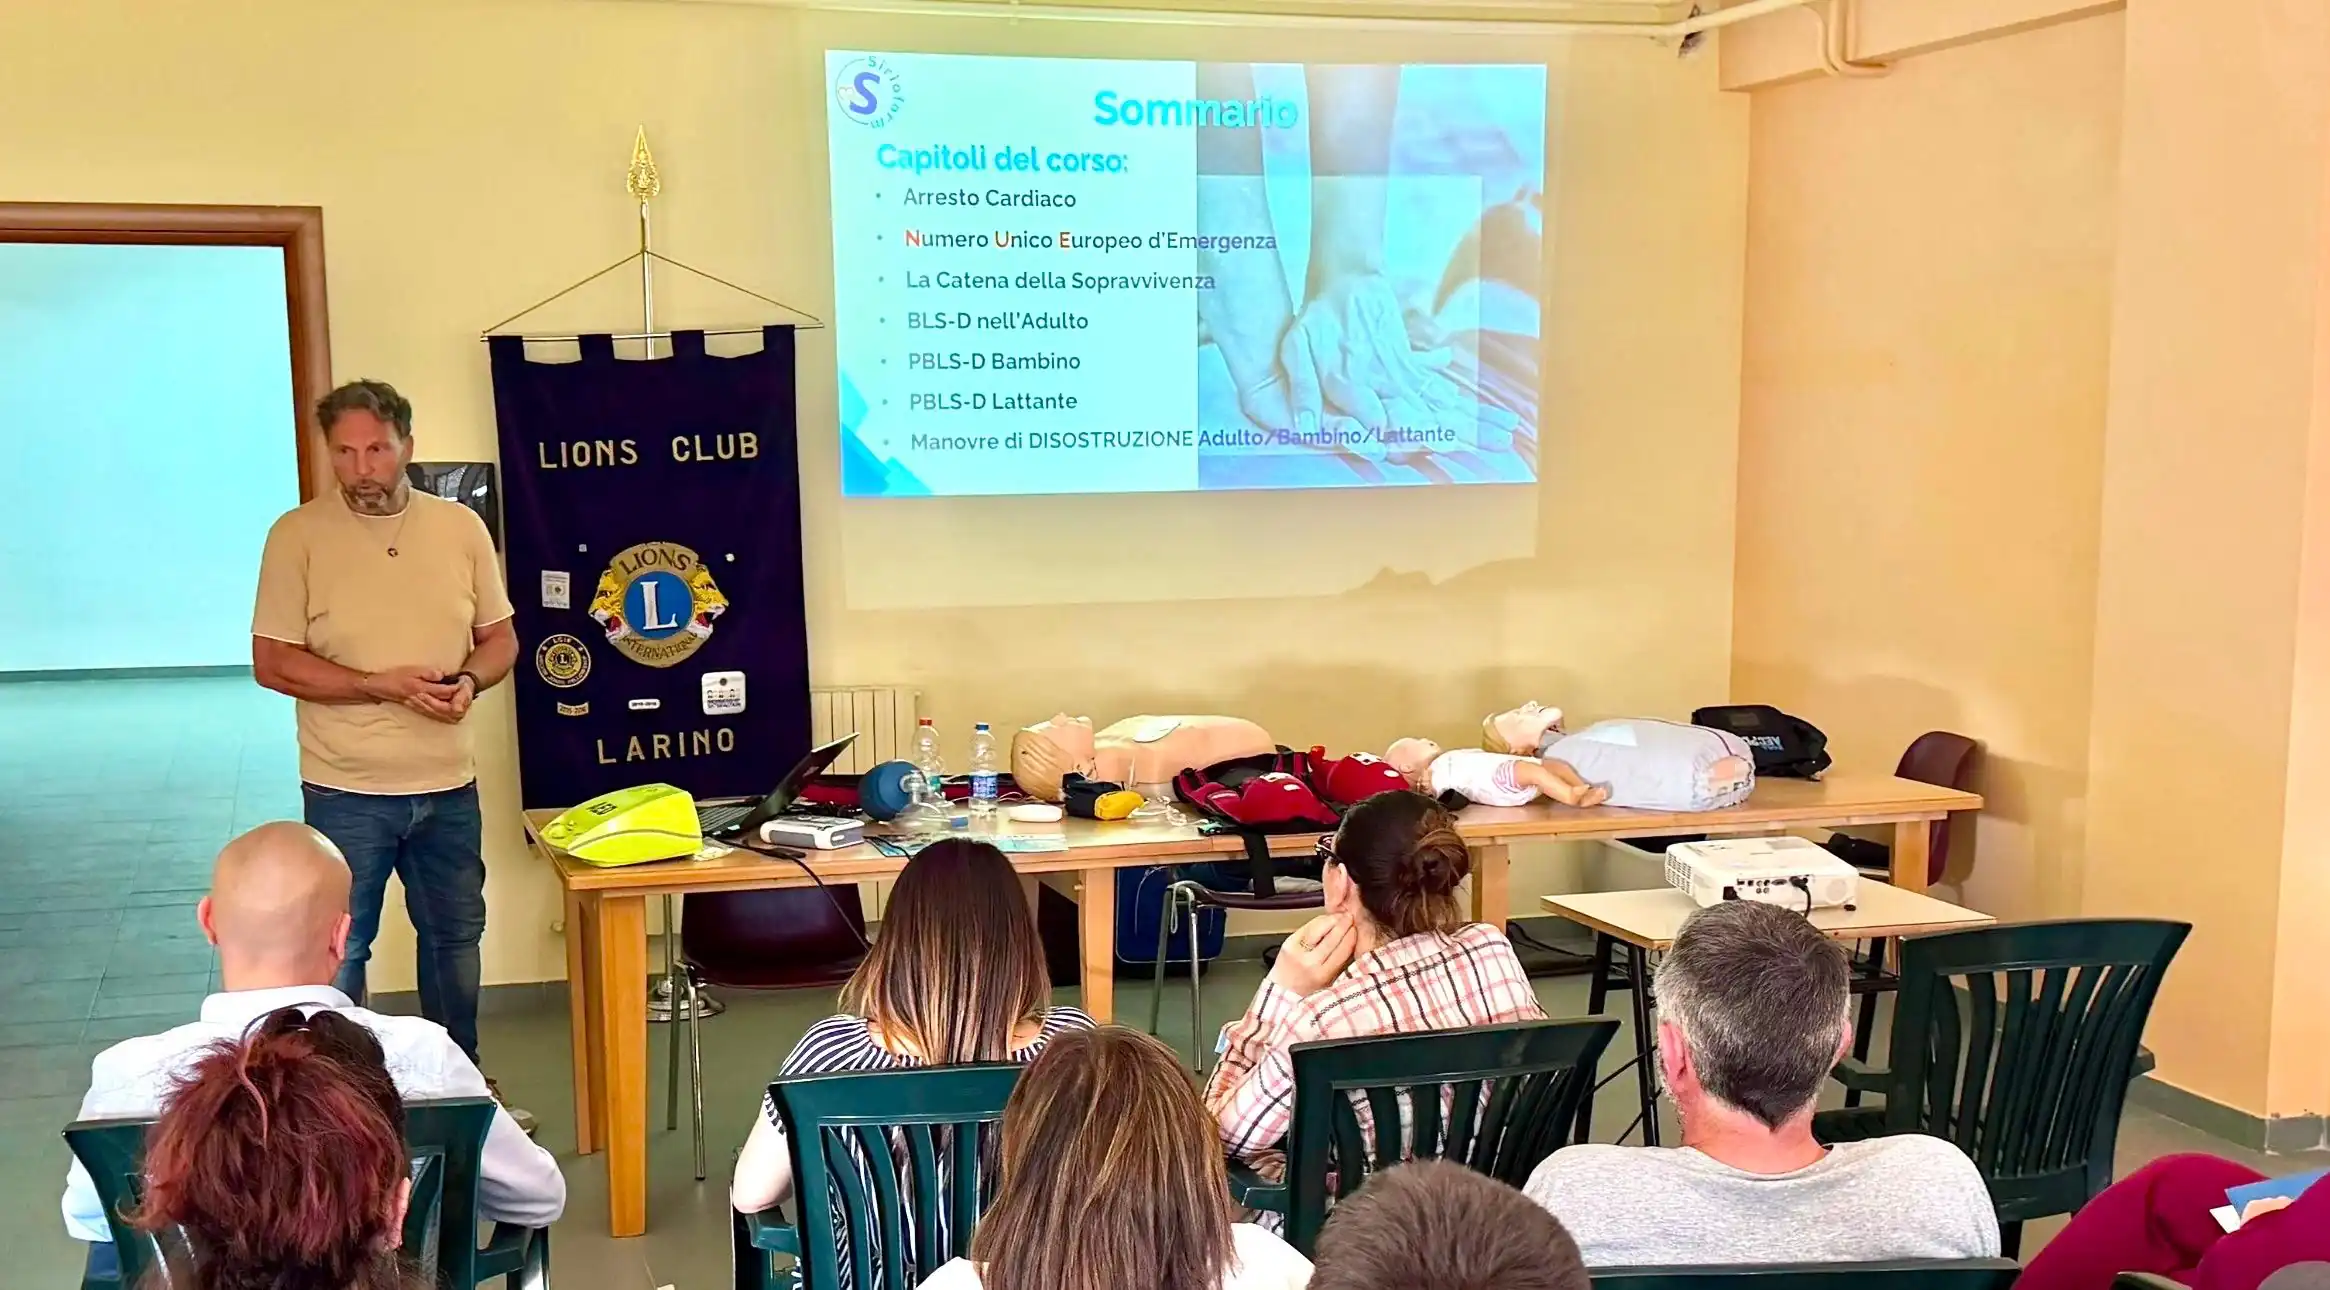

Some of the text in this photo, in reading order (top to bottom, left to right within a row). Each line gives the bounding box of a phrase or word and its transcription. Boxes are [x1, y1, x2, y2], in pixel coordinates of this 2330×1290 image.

[849, 71, 881, 115] S
[1093, 90, 1298, 129] Sommario
[876, 143, 1129, 175] Capitoli del corso:
[903, 187, 1077, 209] Arresto Cardiaco
[905, 229, 1277, 254] Numero Unico Europeo d'Emergenza
[906, 271, 1217, 294] La Catena della Sopravvivenza
[908, 311, 1089, 330] BLS-D nell'Adulto
[908, 352, 1082, 371] PBLS-D Bambino
[910, 392, 1078, 411] PBLS-D Lattante
[538, 432, 759, 469] LIONS CLUB
[911, 426, 1456, 451] Manovre di DISOSTRUZIONE Adulto/Bambino/Lattante
[618, 548, 691, 576] LIONS
[639, 580, 679, 630] L
[596, 727, 735, 765] LARINO
